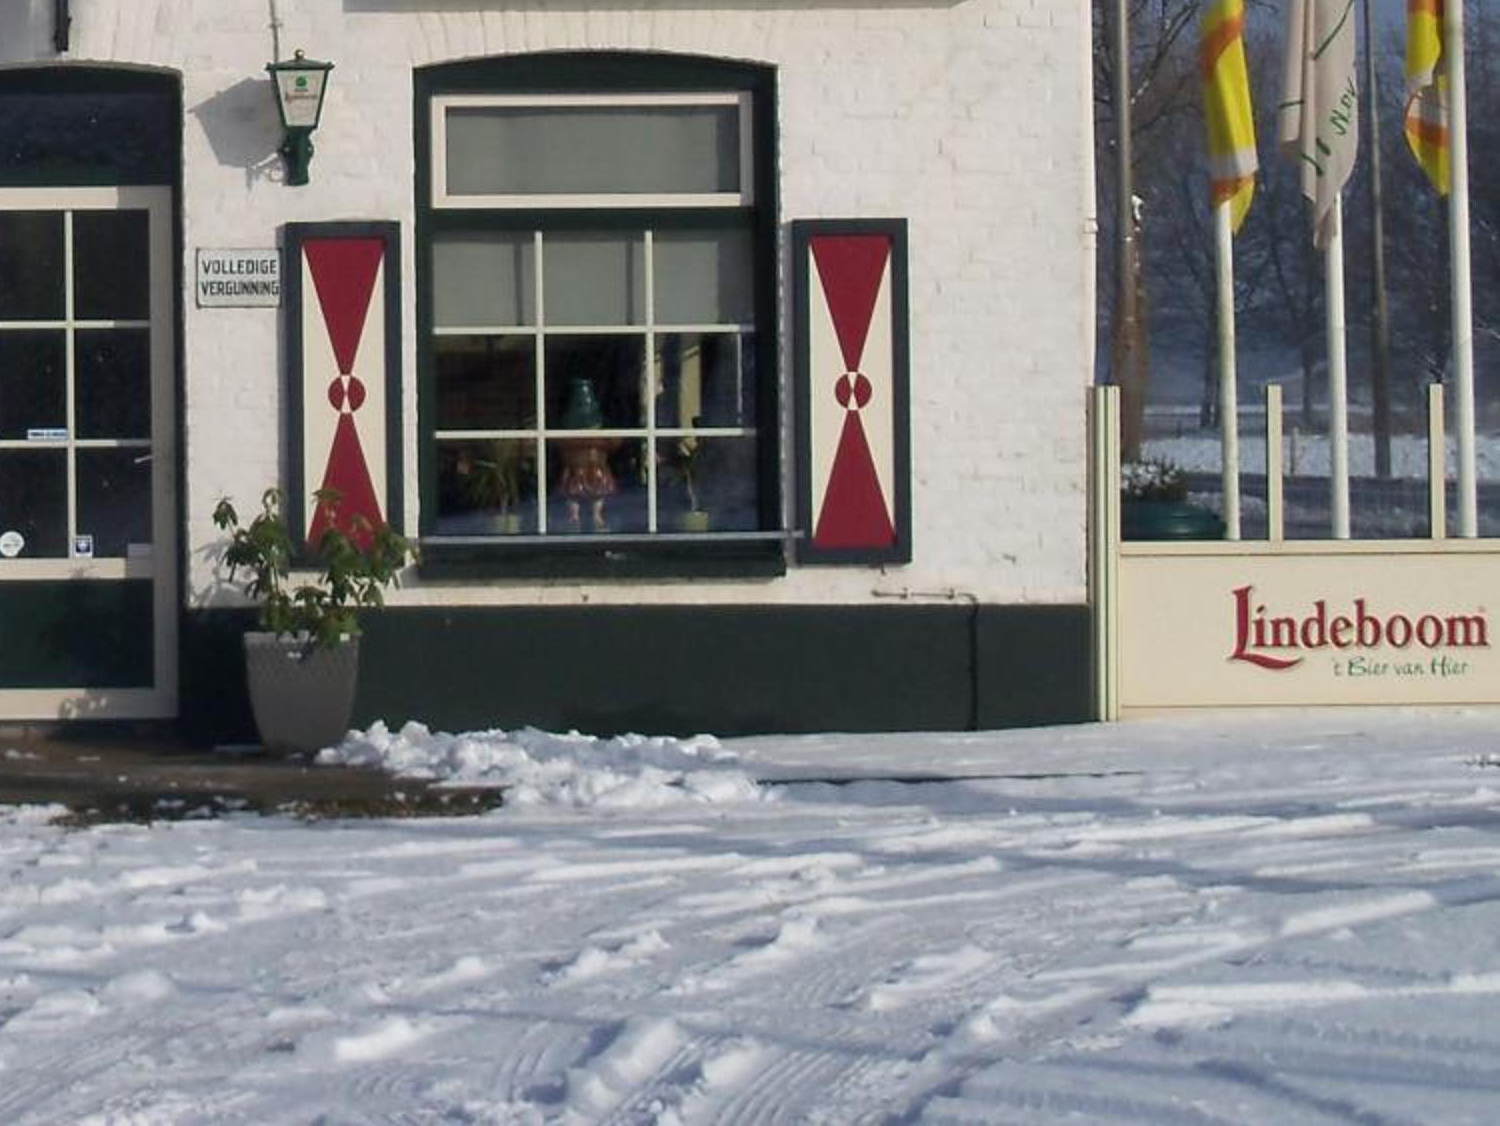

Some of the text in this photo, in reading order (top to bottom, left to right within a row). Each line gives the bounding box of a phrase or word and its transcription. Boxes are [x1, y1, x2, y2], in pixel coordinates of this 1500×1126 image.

[201, 259, 277, 275] VOLLEDIGE
[201, 280, 280, 296] VERGUNNING
[1227, 585, 1489, 670] Lindeboom
[1347, 656, 1388, 676] Bier
[1393, 663, 1424, 675] van
[1431, 655, 1468, 676] Hier
